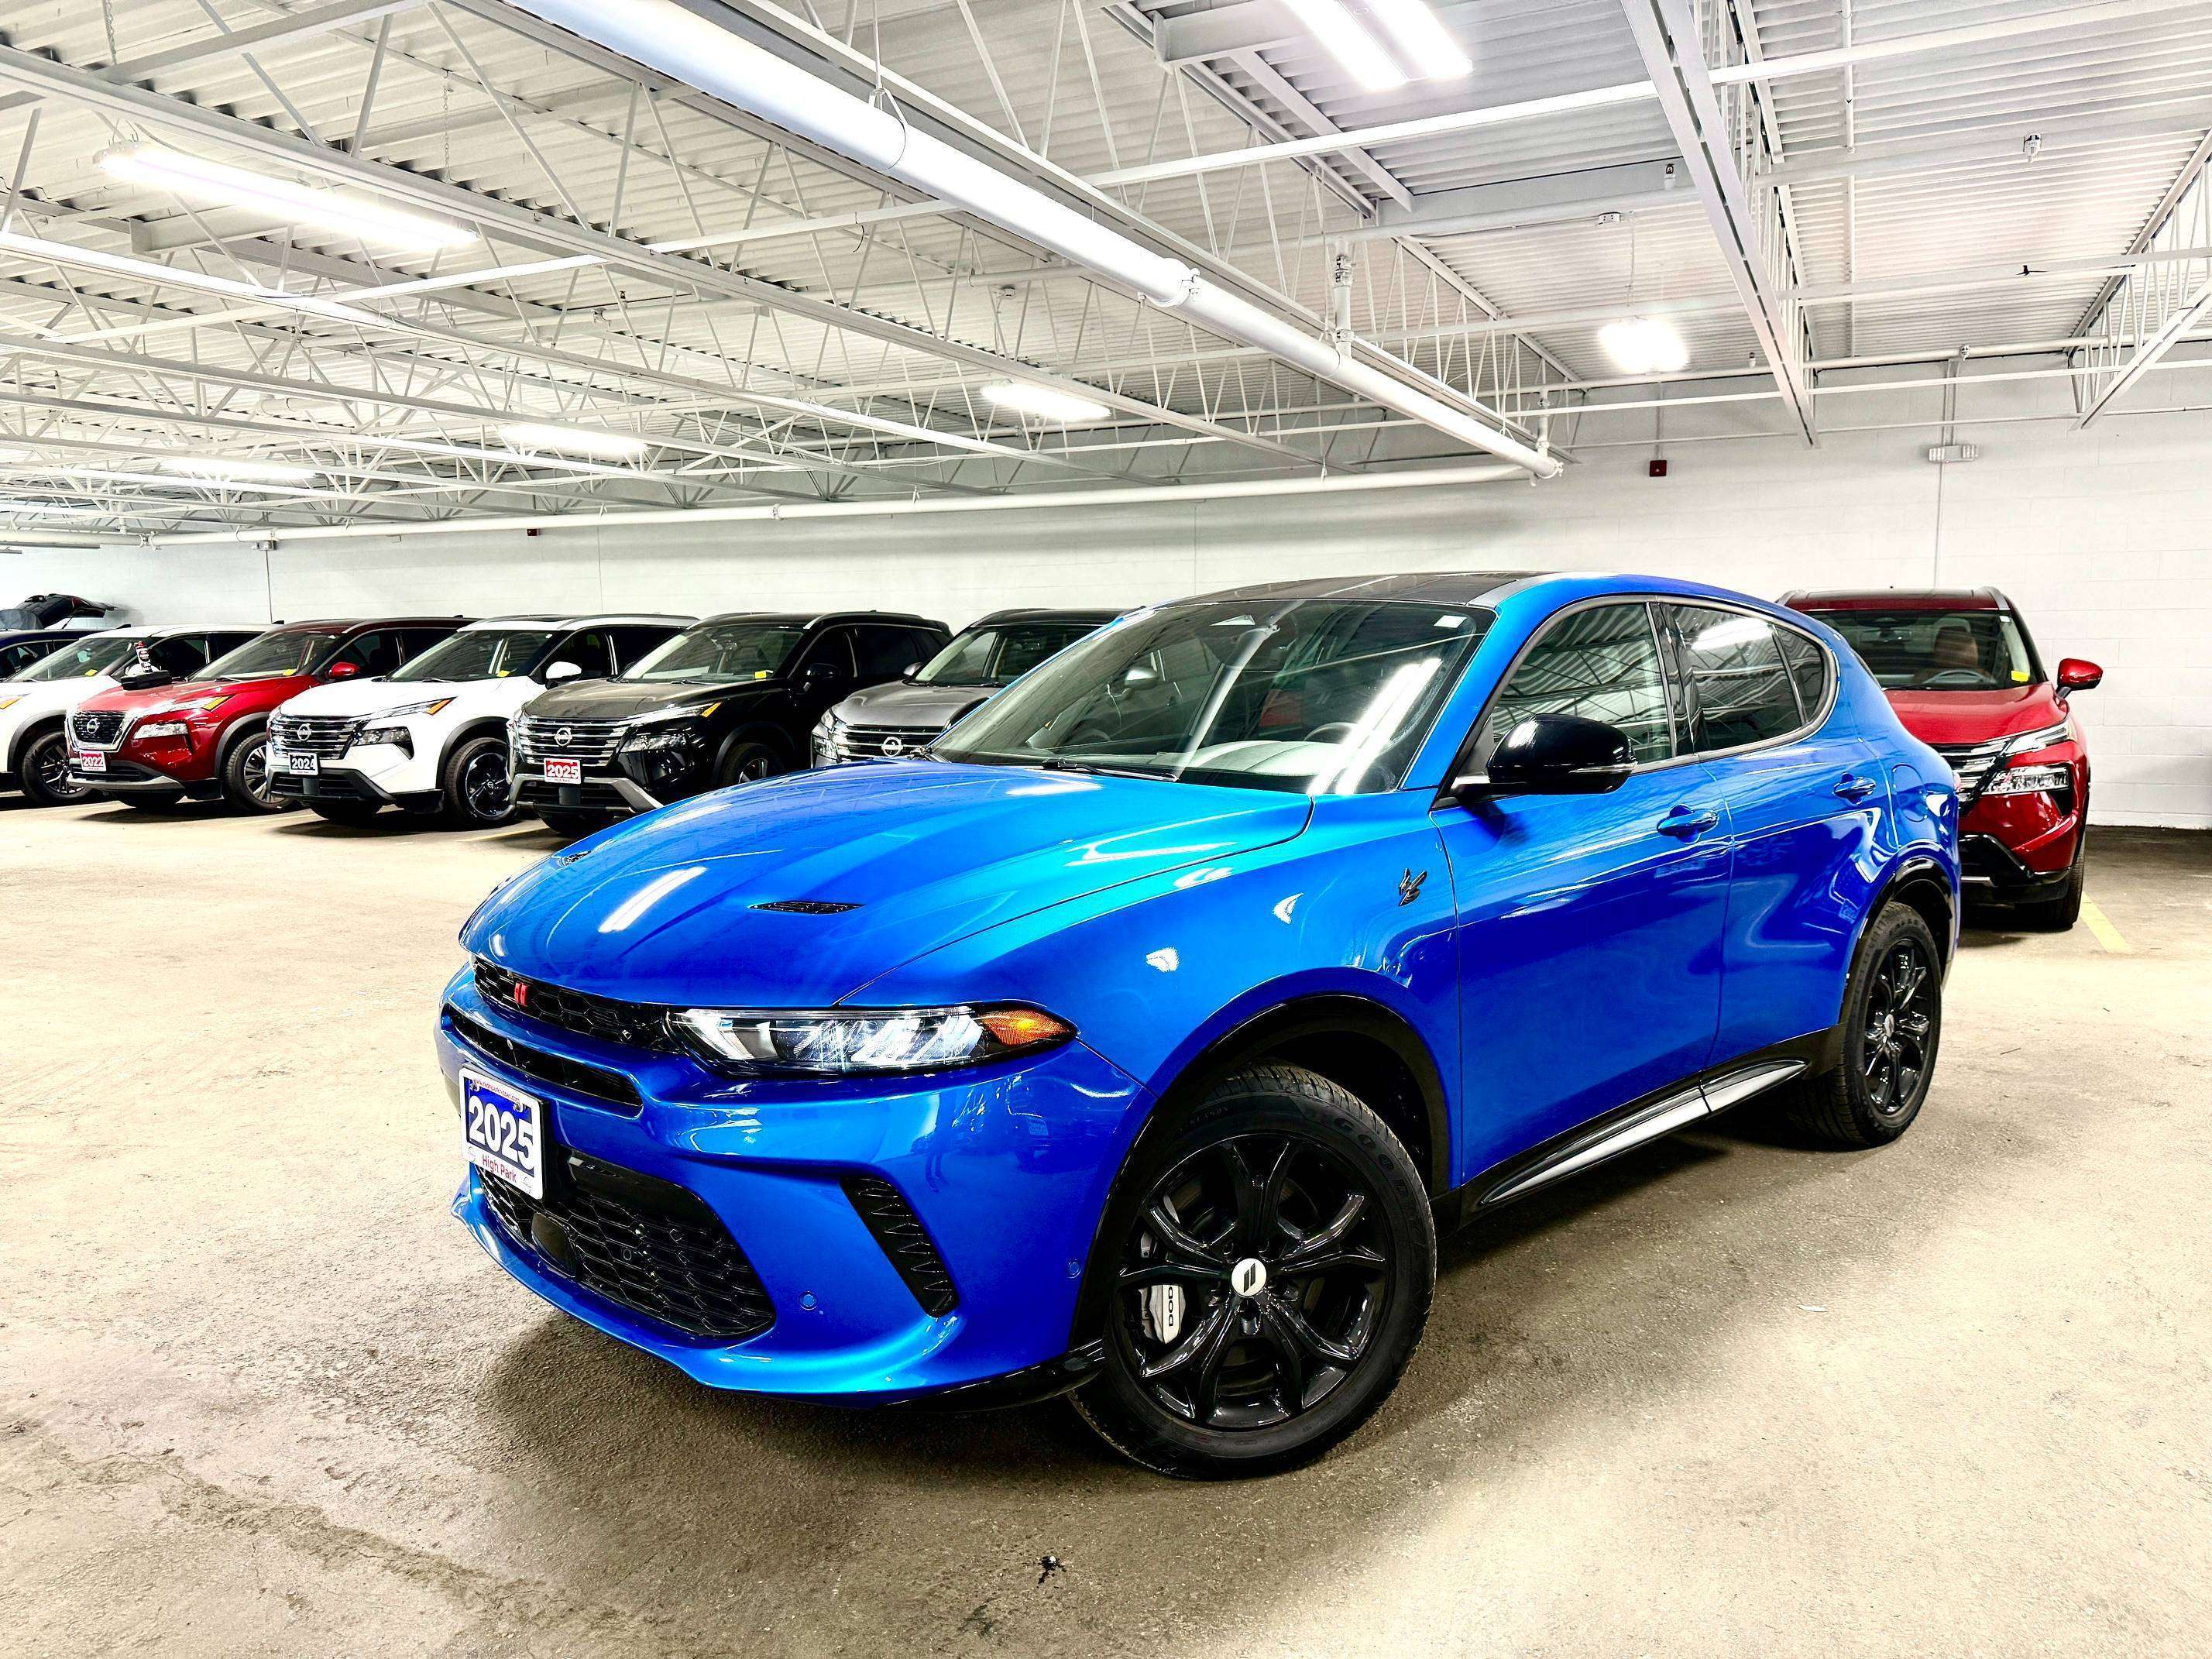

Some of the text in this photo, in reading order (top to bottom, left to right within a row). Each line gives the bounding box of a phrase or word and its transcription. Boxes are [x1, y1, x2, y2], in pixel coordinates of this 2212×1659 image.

[83, 756, 104, 767] 2022
[291, 757, 315, 769] 2024
[547, 764, 579, 778] 2025
[469, 1095, 534, 1170] 2025
[482, 1154, 499, 1173] High
[500, 1163, 517, 1183] Park
